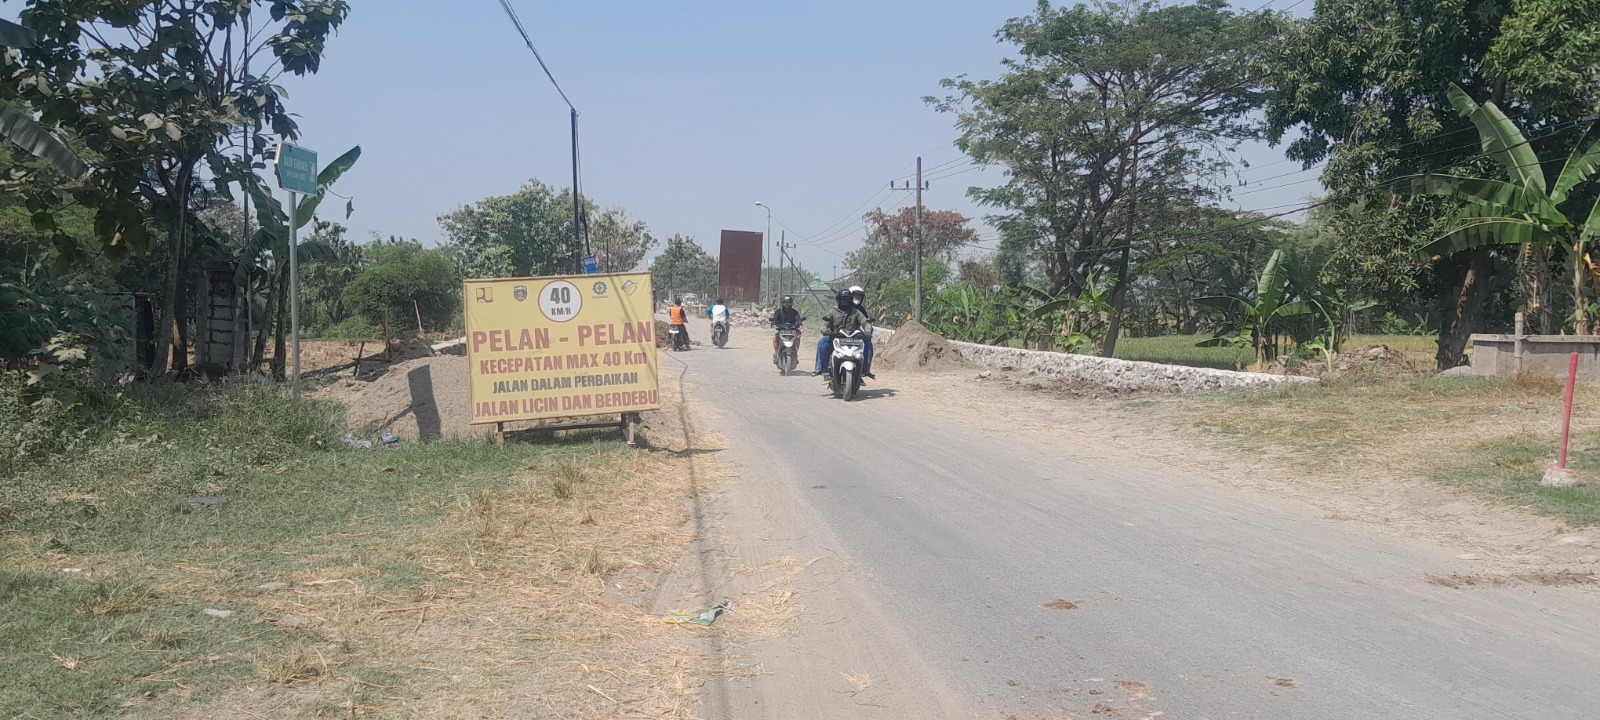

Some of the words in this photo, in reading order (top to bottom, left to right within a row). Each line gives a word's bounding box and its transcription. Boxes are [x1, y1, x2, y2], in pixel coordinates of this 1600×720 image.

[550, 286, 571, 304] 40
[551, 307, 571, 316] KM/H
[472, 327, 550, 353] PELAN
[578, 321, 652, 347] PELAN
[480, 355, 562, 375] KECEPATAN
[566, 353, 599, 370] MAX
[603, 351, 621, 367] 40
[624, 350, 648, 365] Km
[492, 379, 528, 394] JALAN
[531, 376, 572, 391] DALAM
[574, 372, 638, 388] PERBAIKAN
[475, 399, 519, 418] JALAN
[522, 396, 559, 414] LICIN
[562, 394, 592, 411] DAN
[595, 389, 657, 409] BERDEBU
